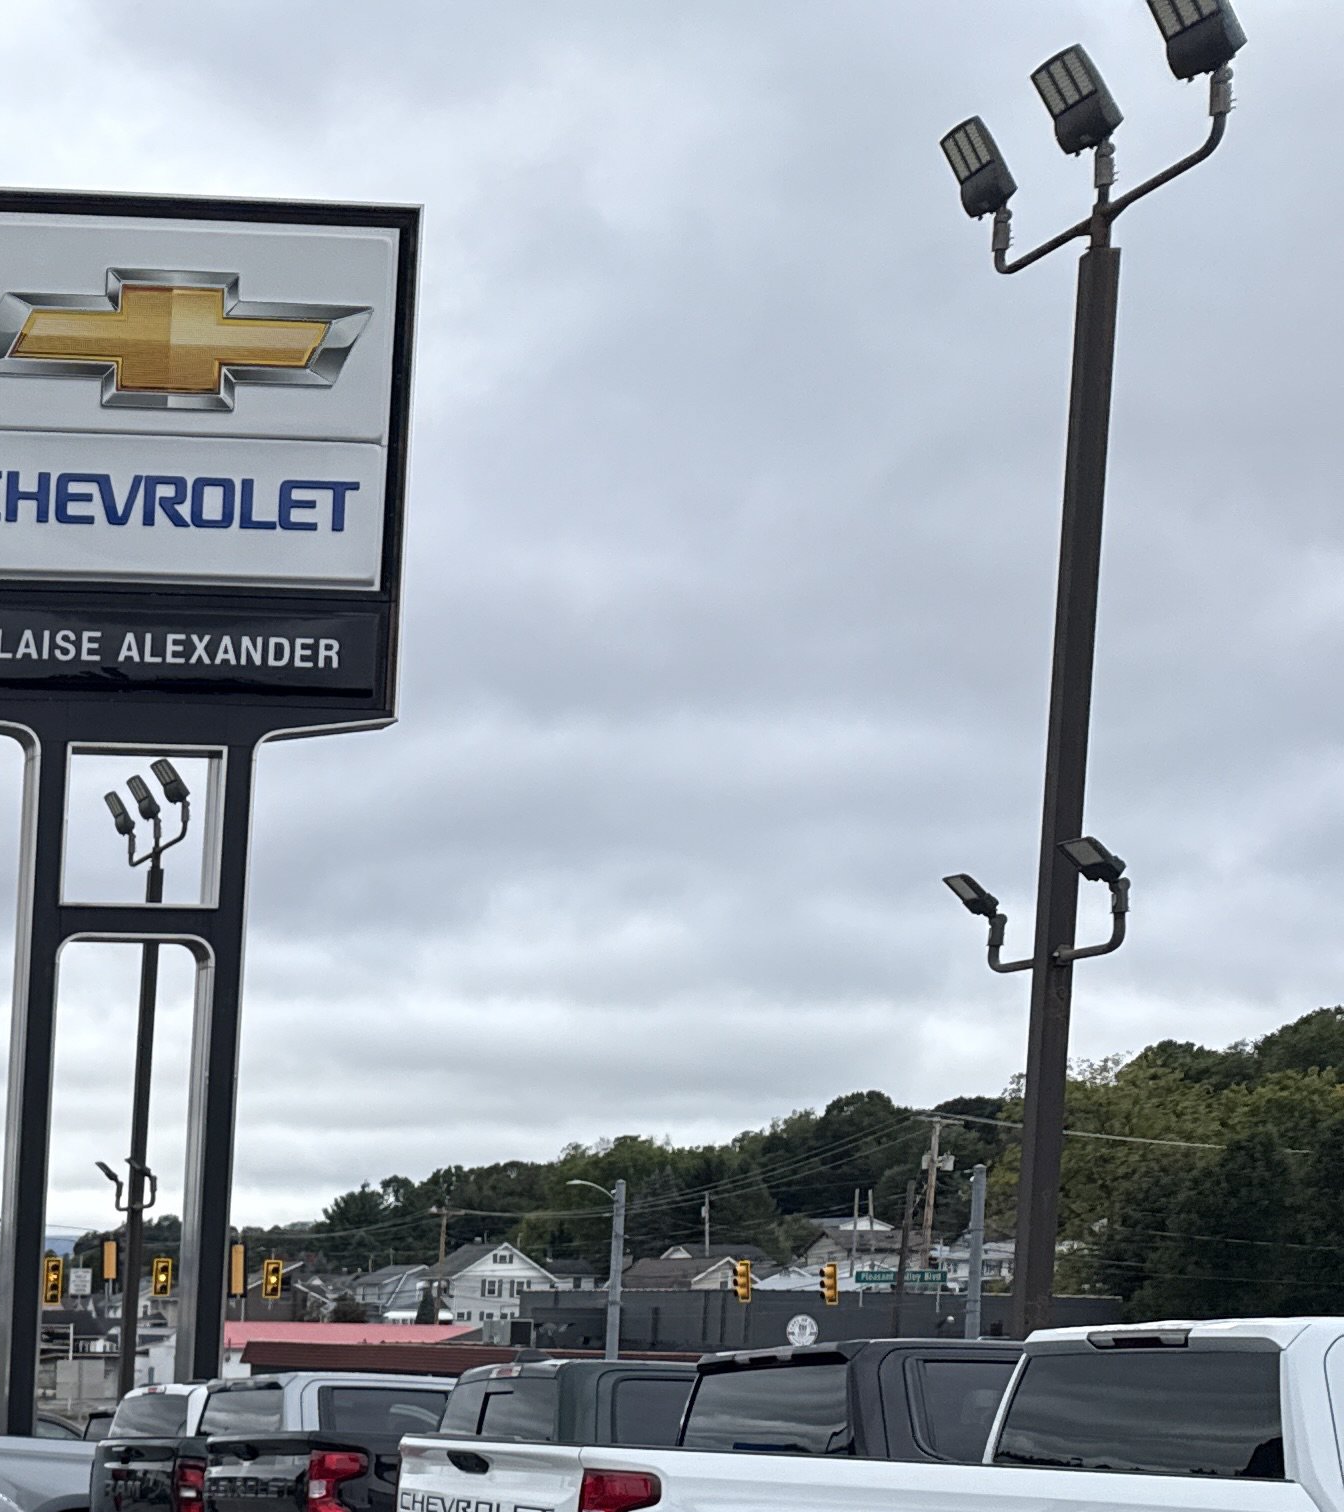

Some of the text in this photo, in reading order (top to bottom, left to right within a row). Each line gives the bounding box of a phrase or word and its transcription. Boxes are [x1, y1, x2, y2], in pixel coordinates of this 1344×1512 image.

[117, 631, 340, 669] ALEXANDER
[861, 1272, 894, 1281] Pleasant
[104, 1479, 142, 1498] RAM
